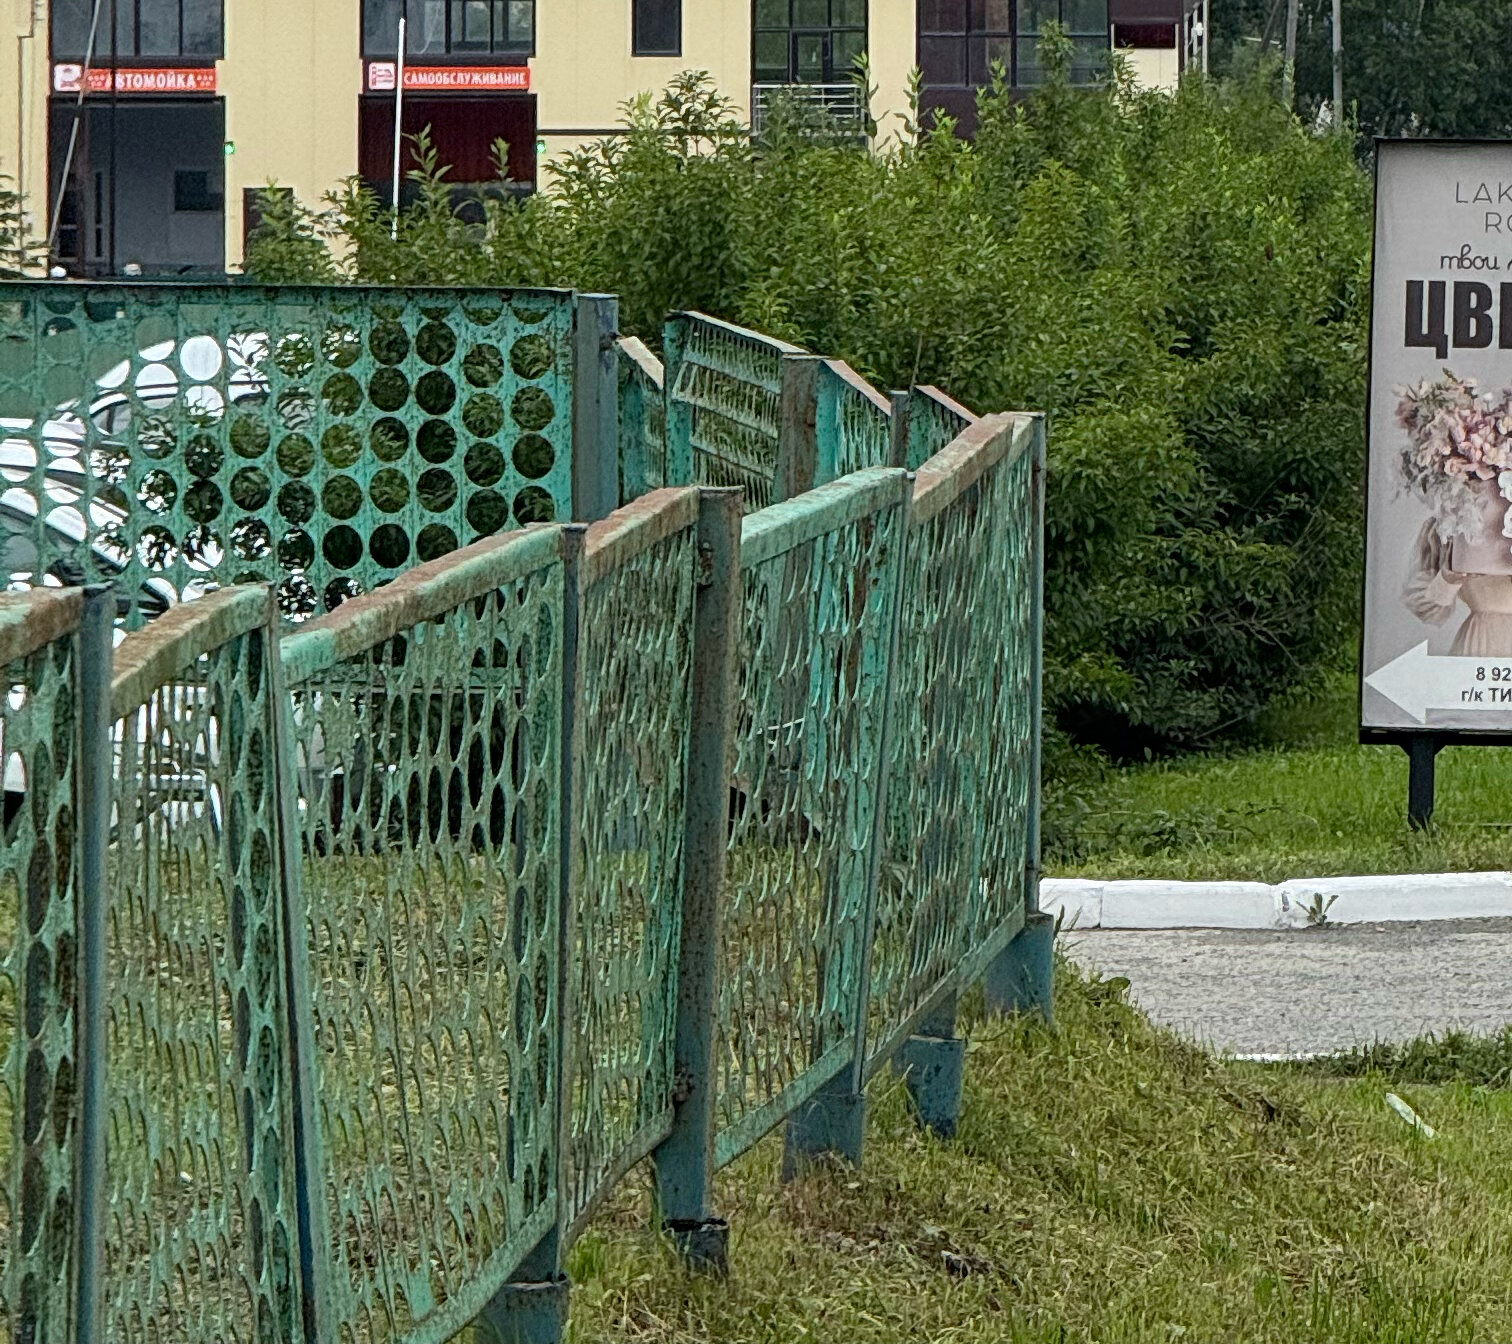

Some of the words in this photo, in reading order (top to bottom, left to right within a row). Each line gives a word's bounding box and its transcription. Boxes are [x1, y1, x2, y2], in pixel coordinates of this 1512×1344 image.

[404, 72, 525, 85] САМООБСЛУЖИВАНИЕ
[1440, 243, 1500, 270] твои
[1476, 667, 1486, 681] 8
[1461, 687, 1483, 703] г/к
